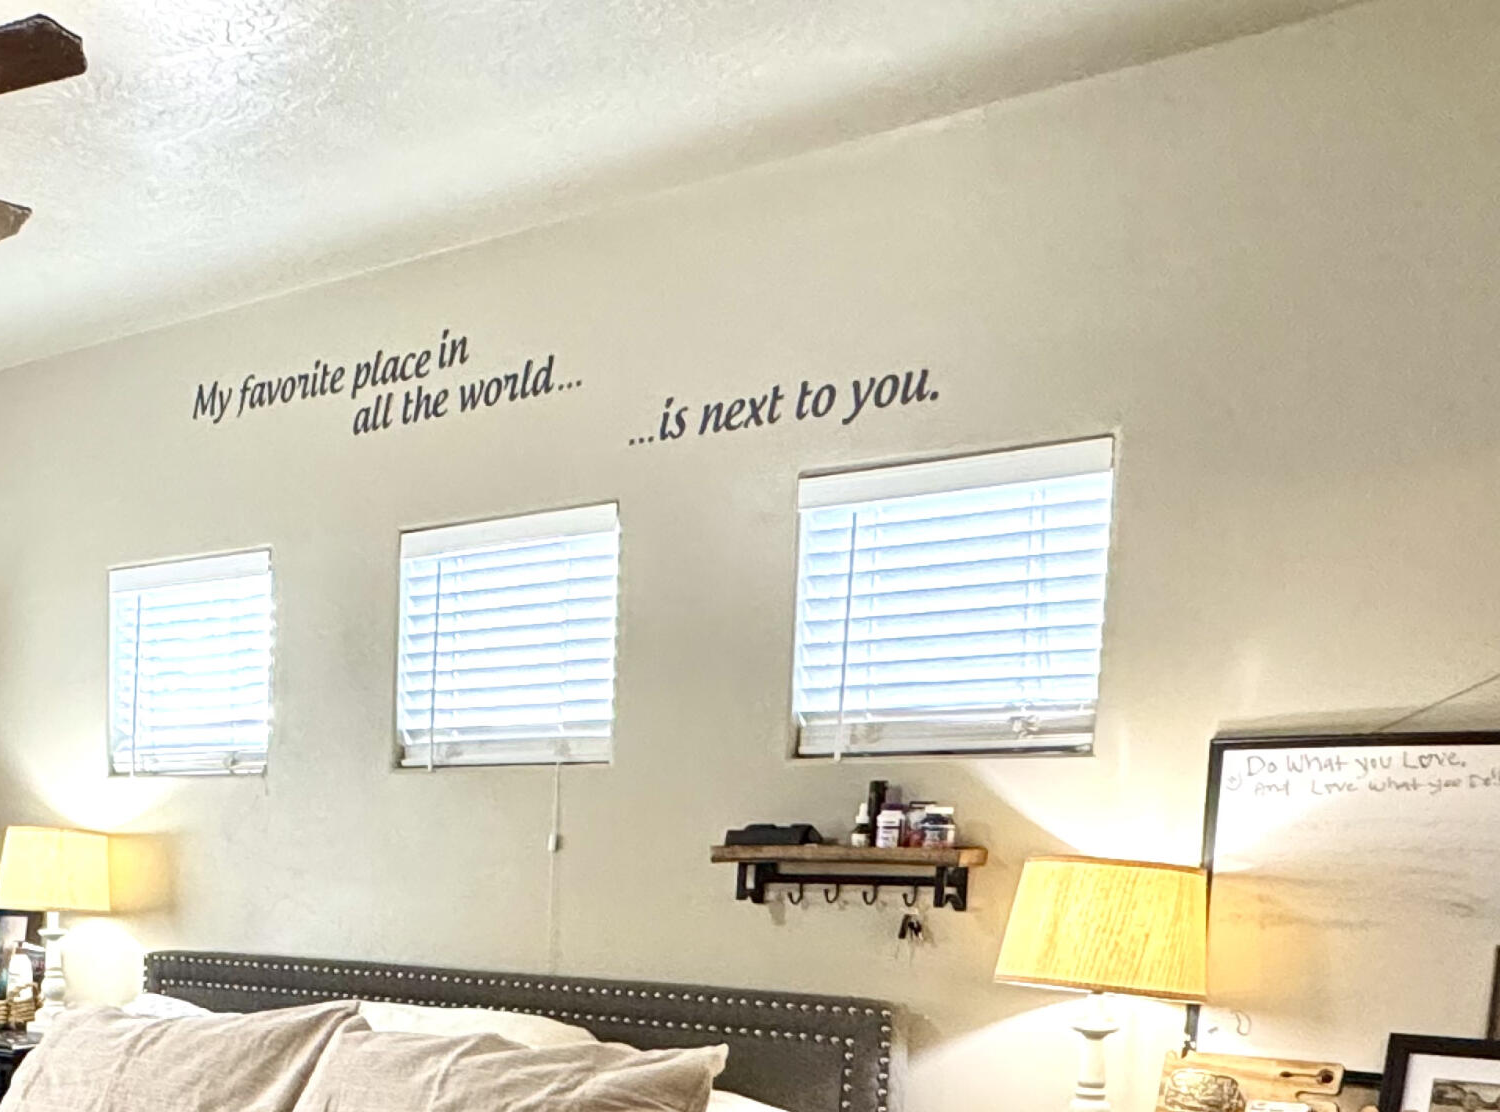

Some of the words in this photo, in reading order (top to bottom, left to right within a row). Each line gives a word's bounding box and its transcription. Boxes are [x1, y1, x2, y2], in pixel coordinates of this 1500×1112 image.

[192, 381, 233, 424] My
[236, 359, 345, 417] favorite
[351, 349, 432, 400] place
[438, 328, 469, 370] in
[353, 391, 394, 435] all
[402, 385, 450, 424] the
[459, 354, 582, 412] world...
[628, 396, 688, 446] ...is
[698, 384, 784, 435] next
[796, 380, 837, 421] to
[842, 368, 939, 425] you.
[1247, 755, 1278, 776] Do
